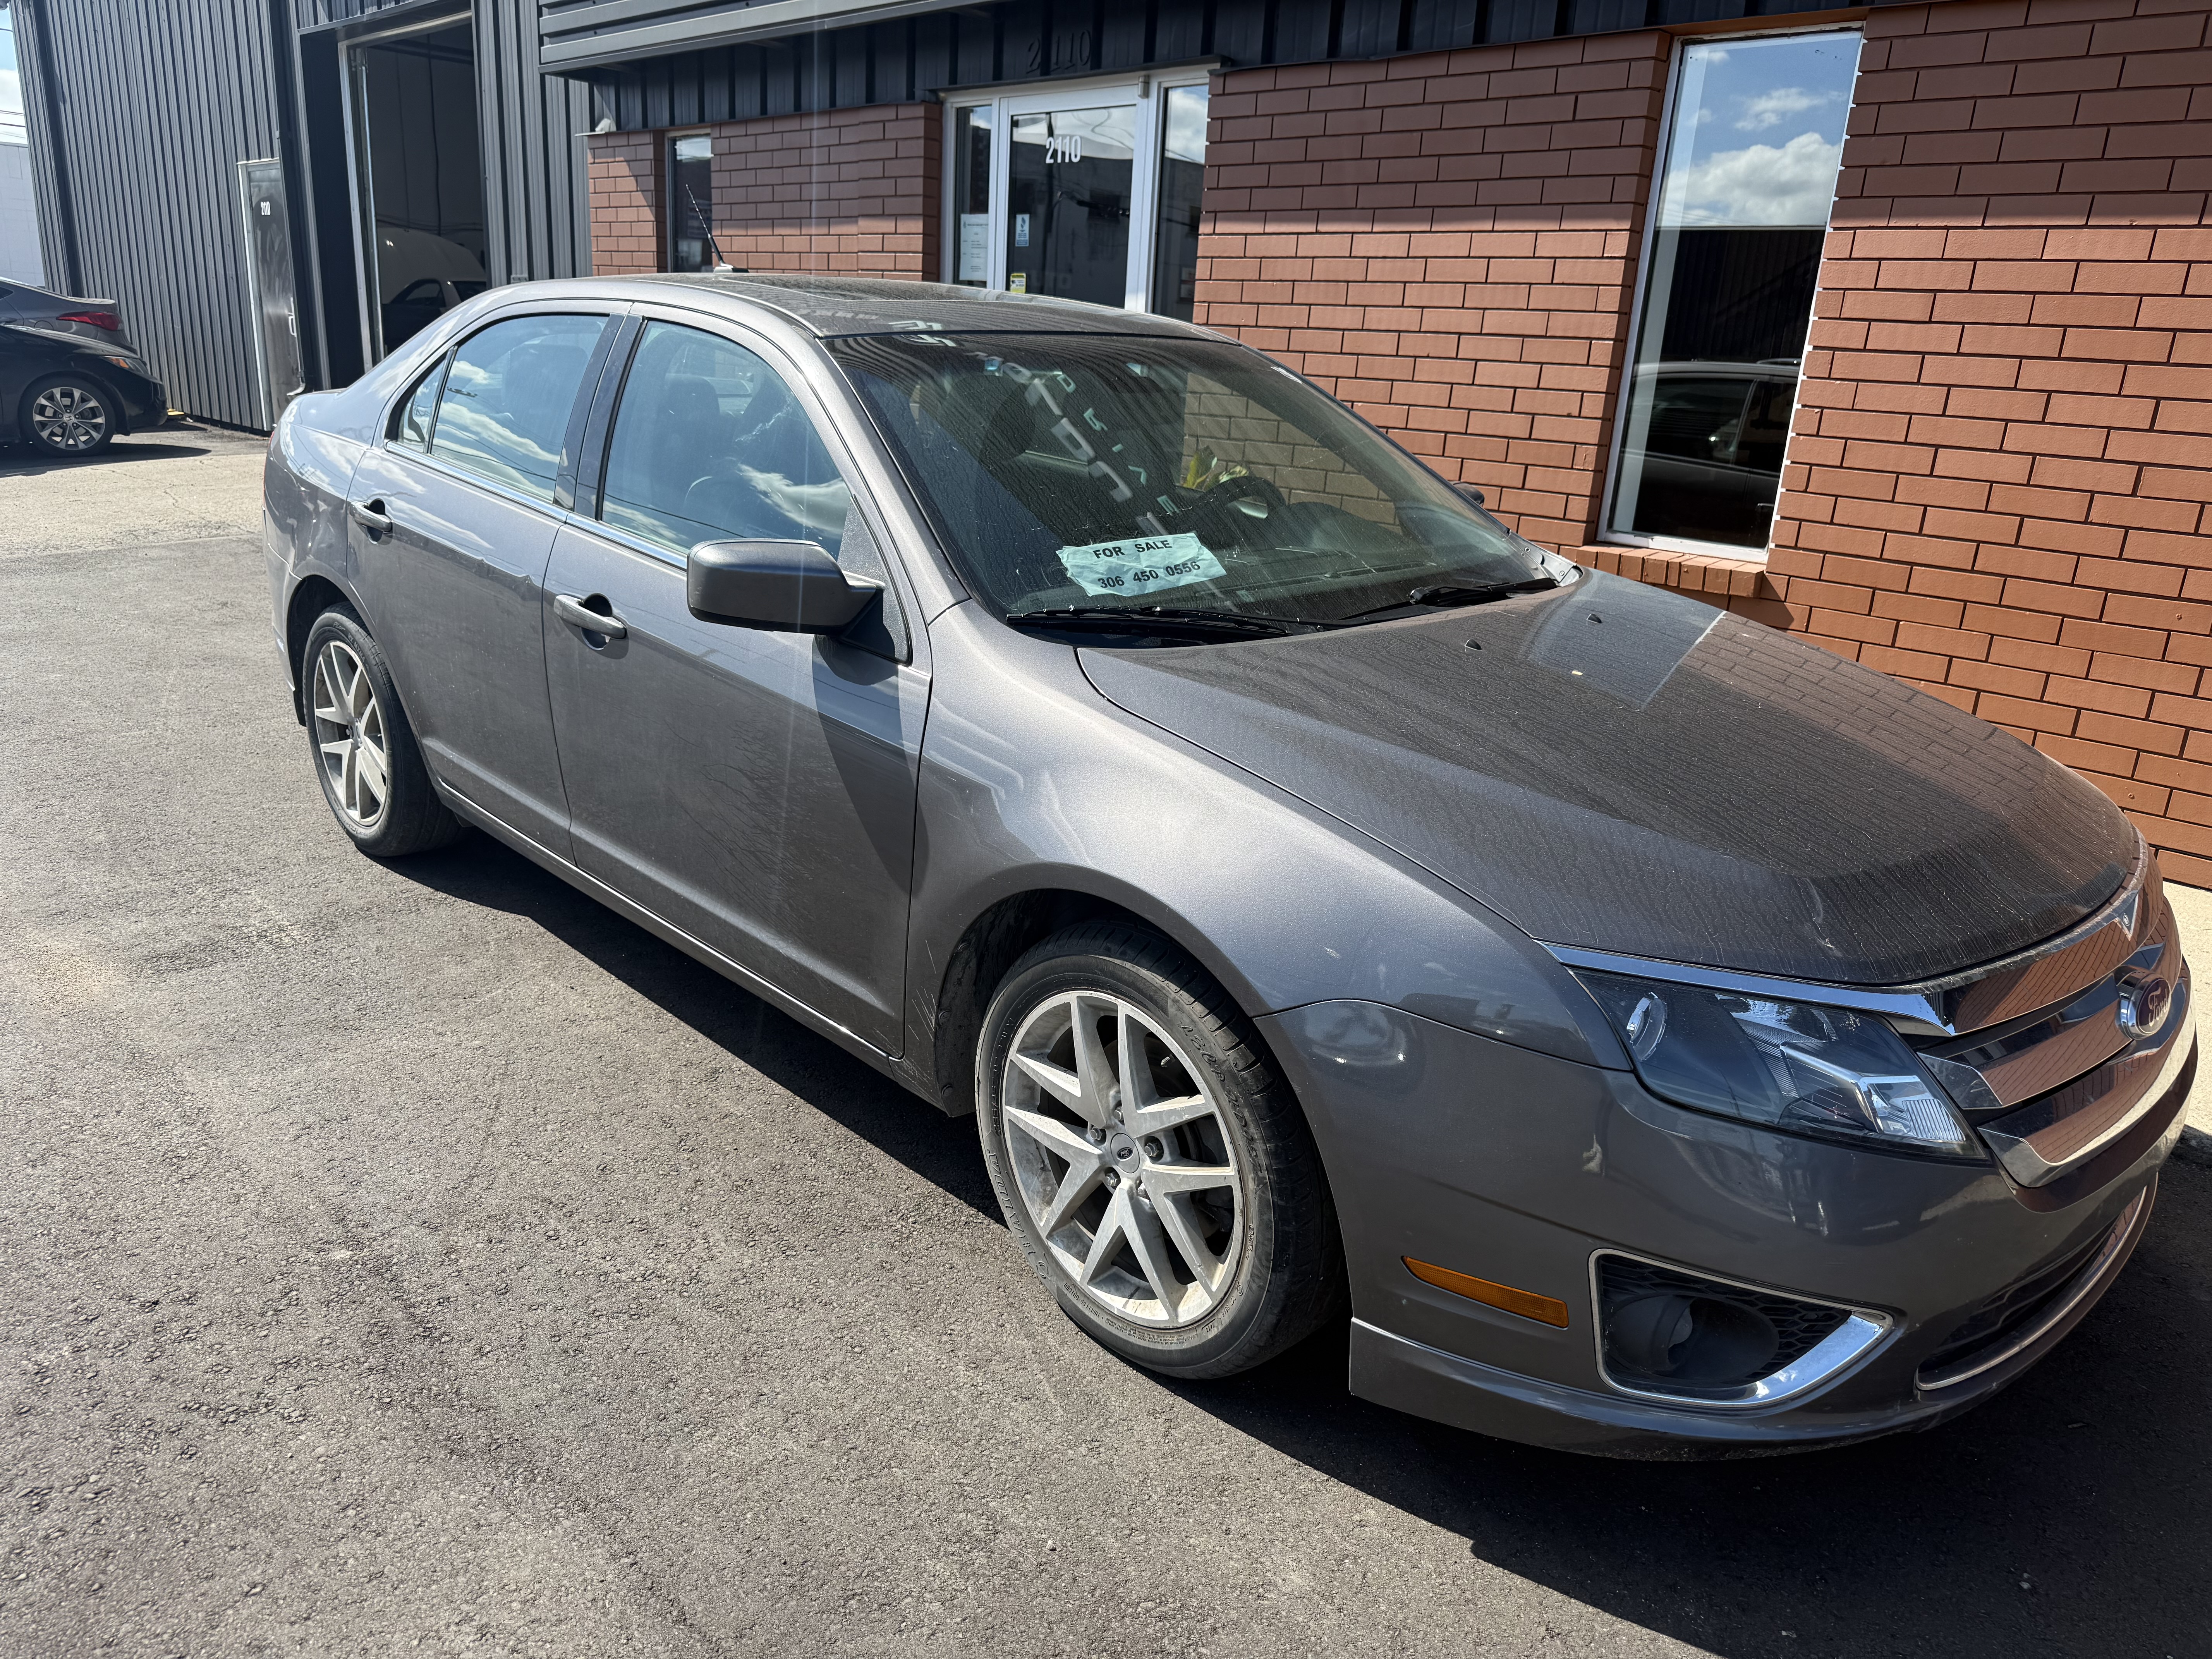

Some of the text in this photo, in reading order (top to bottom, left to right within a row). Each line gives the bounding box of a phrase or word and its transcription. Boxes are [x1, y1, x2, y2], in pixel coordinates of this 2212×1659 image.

[1027, 30, 1091, 74] 2110
[1046, 135, 1081, 163] 2110
[261, 201, 271, 215] 2110
[1092, 540, 1173, 559] FOR SALE
[1097, 561, 1201, 589] 306 450 0556
[2148, 986, 2169, 1027] Ford
